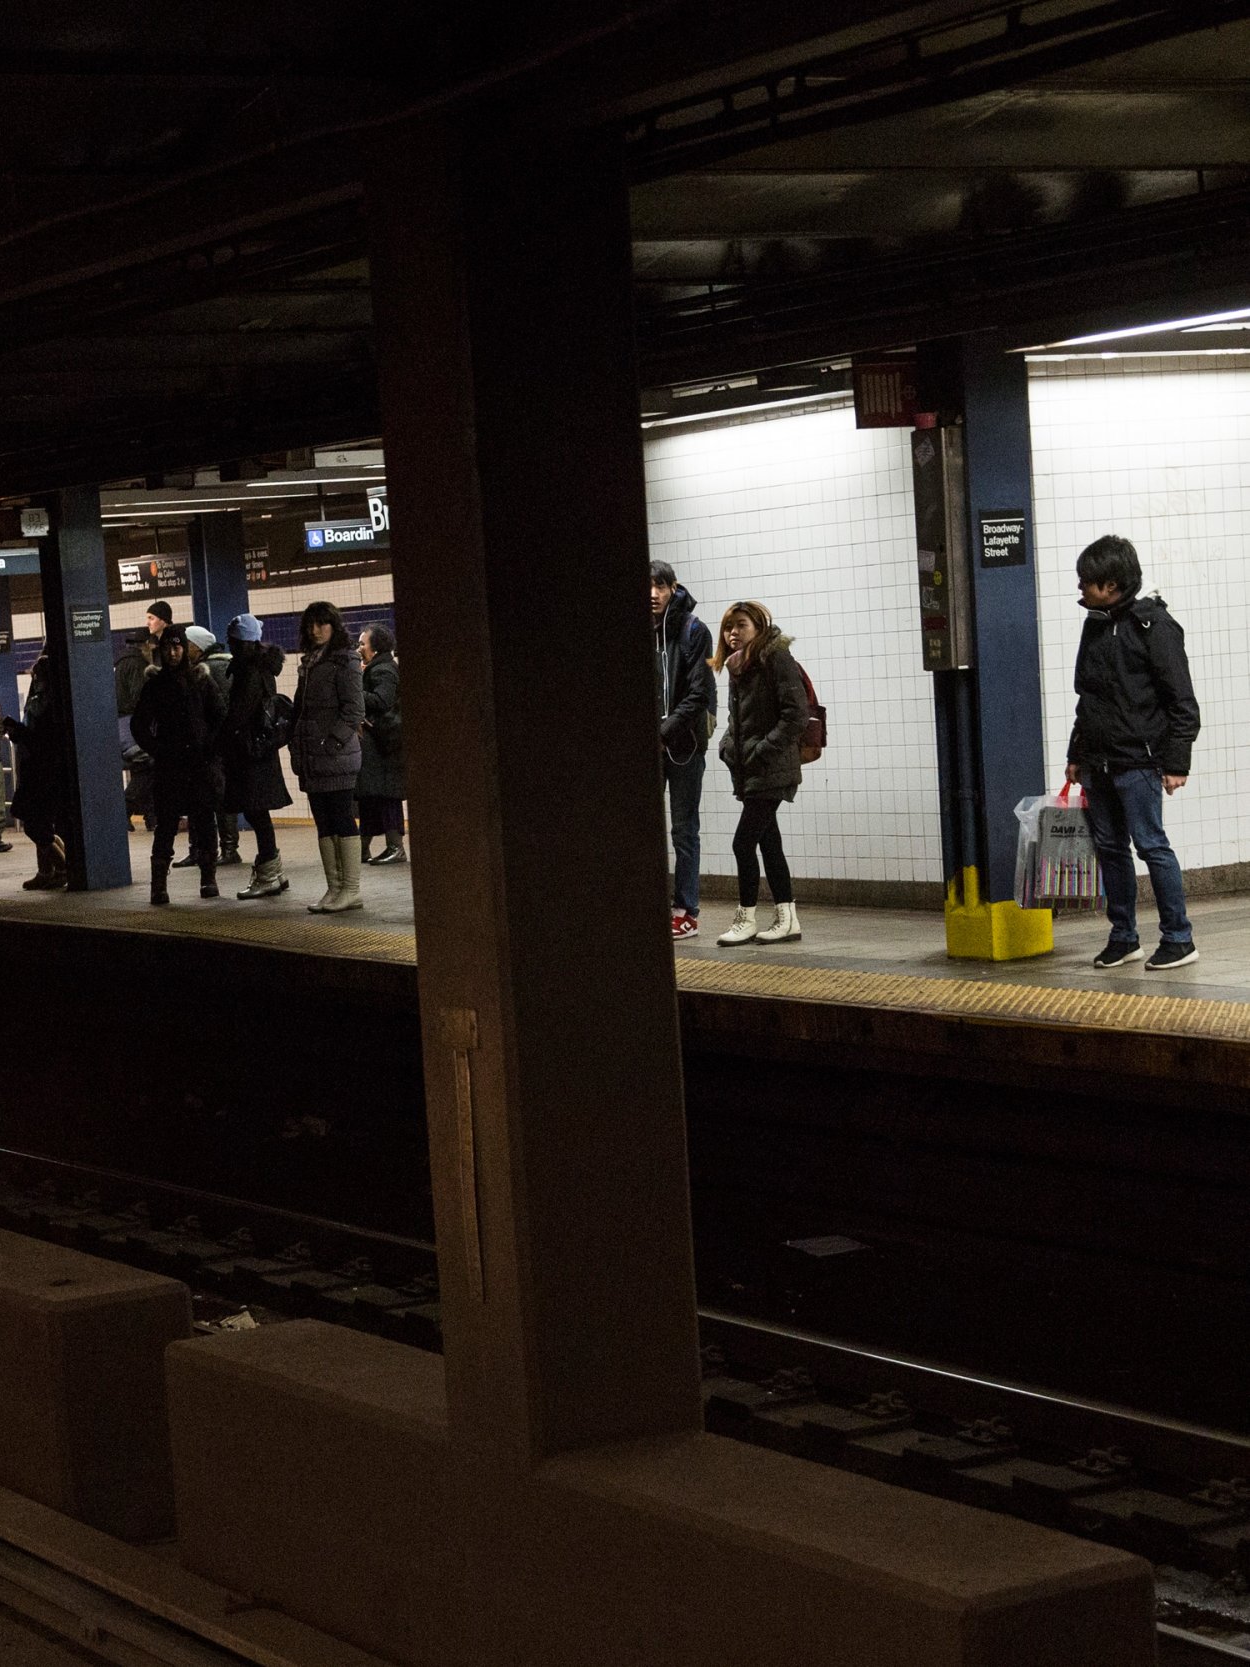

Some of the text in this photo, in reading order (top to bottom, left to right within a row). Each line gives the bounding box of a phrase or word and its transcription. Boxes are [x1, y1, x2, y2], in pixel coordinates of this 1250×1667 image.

[983, 524, 1024, 534] Broadway-
[324, 527, 374, 543] Boardin
[983, 535, 1020, 546] Lafayette
[984, 547, 1009, 557] Street
[73, 621, 101, 629] Lafayette
[73, 629, 92, 637] Street
